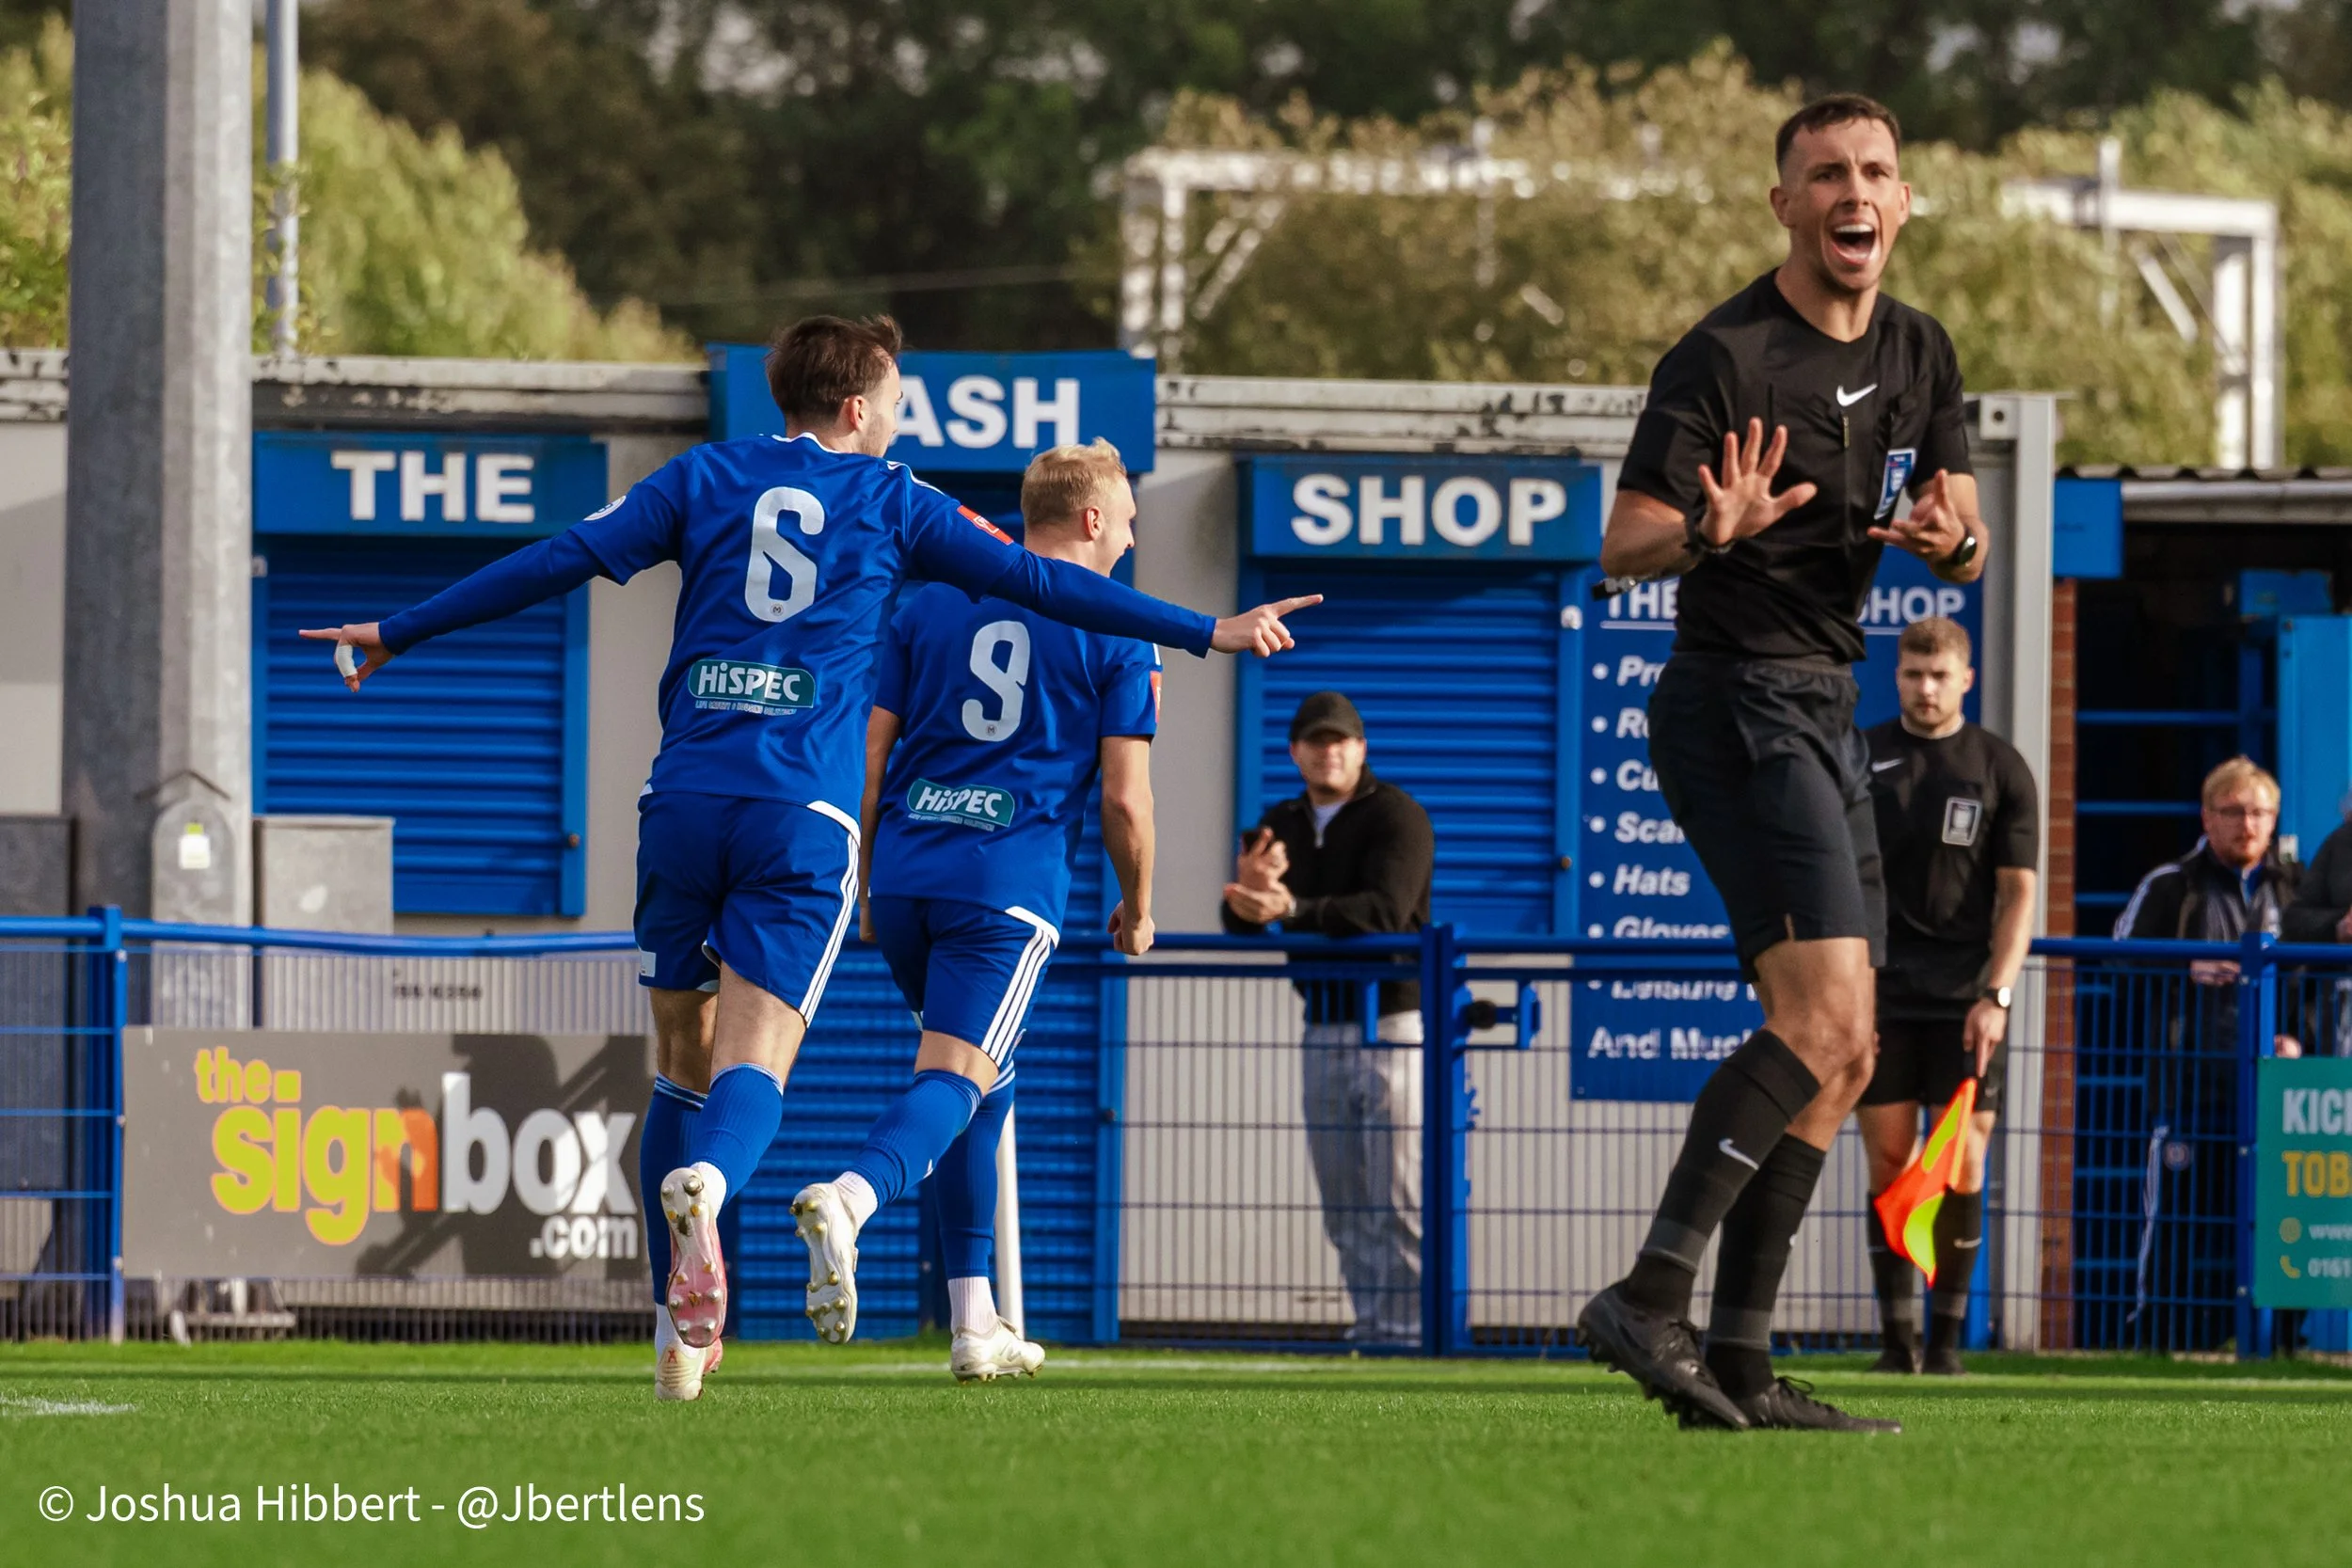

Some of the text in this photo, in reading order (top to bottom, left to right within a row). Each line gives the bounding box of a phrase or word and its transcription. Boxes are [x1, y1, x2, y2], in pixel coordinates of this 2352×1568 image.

[889, 375, 1080, 450] ASH
[331, 451, 535, 523] THE
[1291, 474, 1567, 546] SHOP
[745, 486, 825, 623] 6
[698, 662, 801, 702] HiSPEC
[961, 620, 1031, 742] 9
[915, 786, 1003, 818] HiSPEC
[1613, 863, 1692, 895] Hats
[1587, 1025, 1661, 1059] And
[195, 1046, 273, 1104] the
[2280, 1150, 2352, 1198] TOB
[529, 1215, 639, 1259] .com
